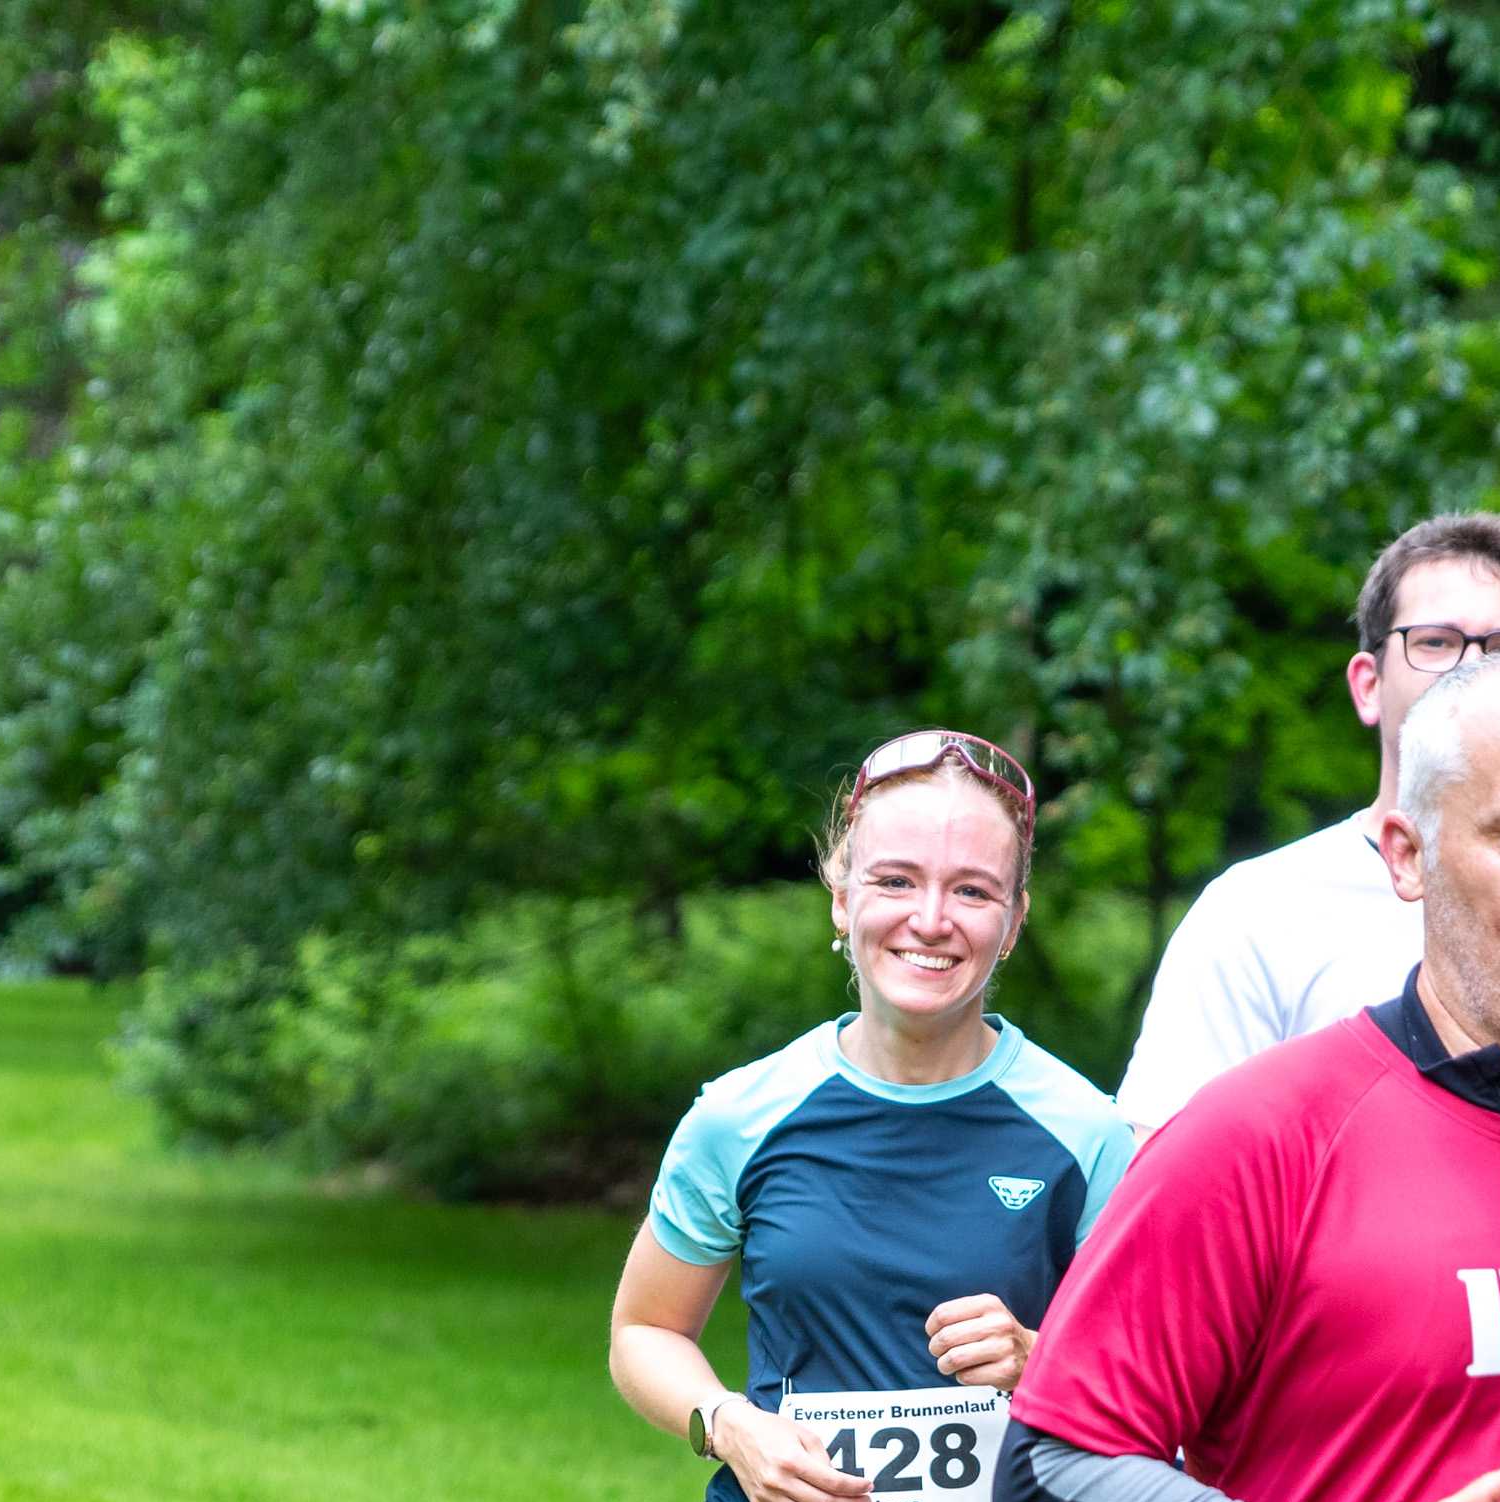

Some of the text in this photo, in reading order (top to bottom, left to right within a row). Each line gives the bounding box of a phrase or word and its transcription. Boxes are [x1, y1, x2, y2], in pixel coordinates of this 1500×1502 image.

[794, 1399, 995, 1420] Everstener Brunnenlauf
[826, 1423, 981, 1492] 428
